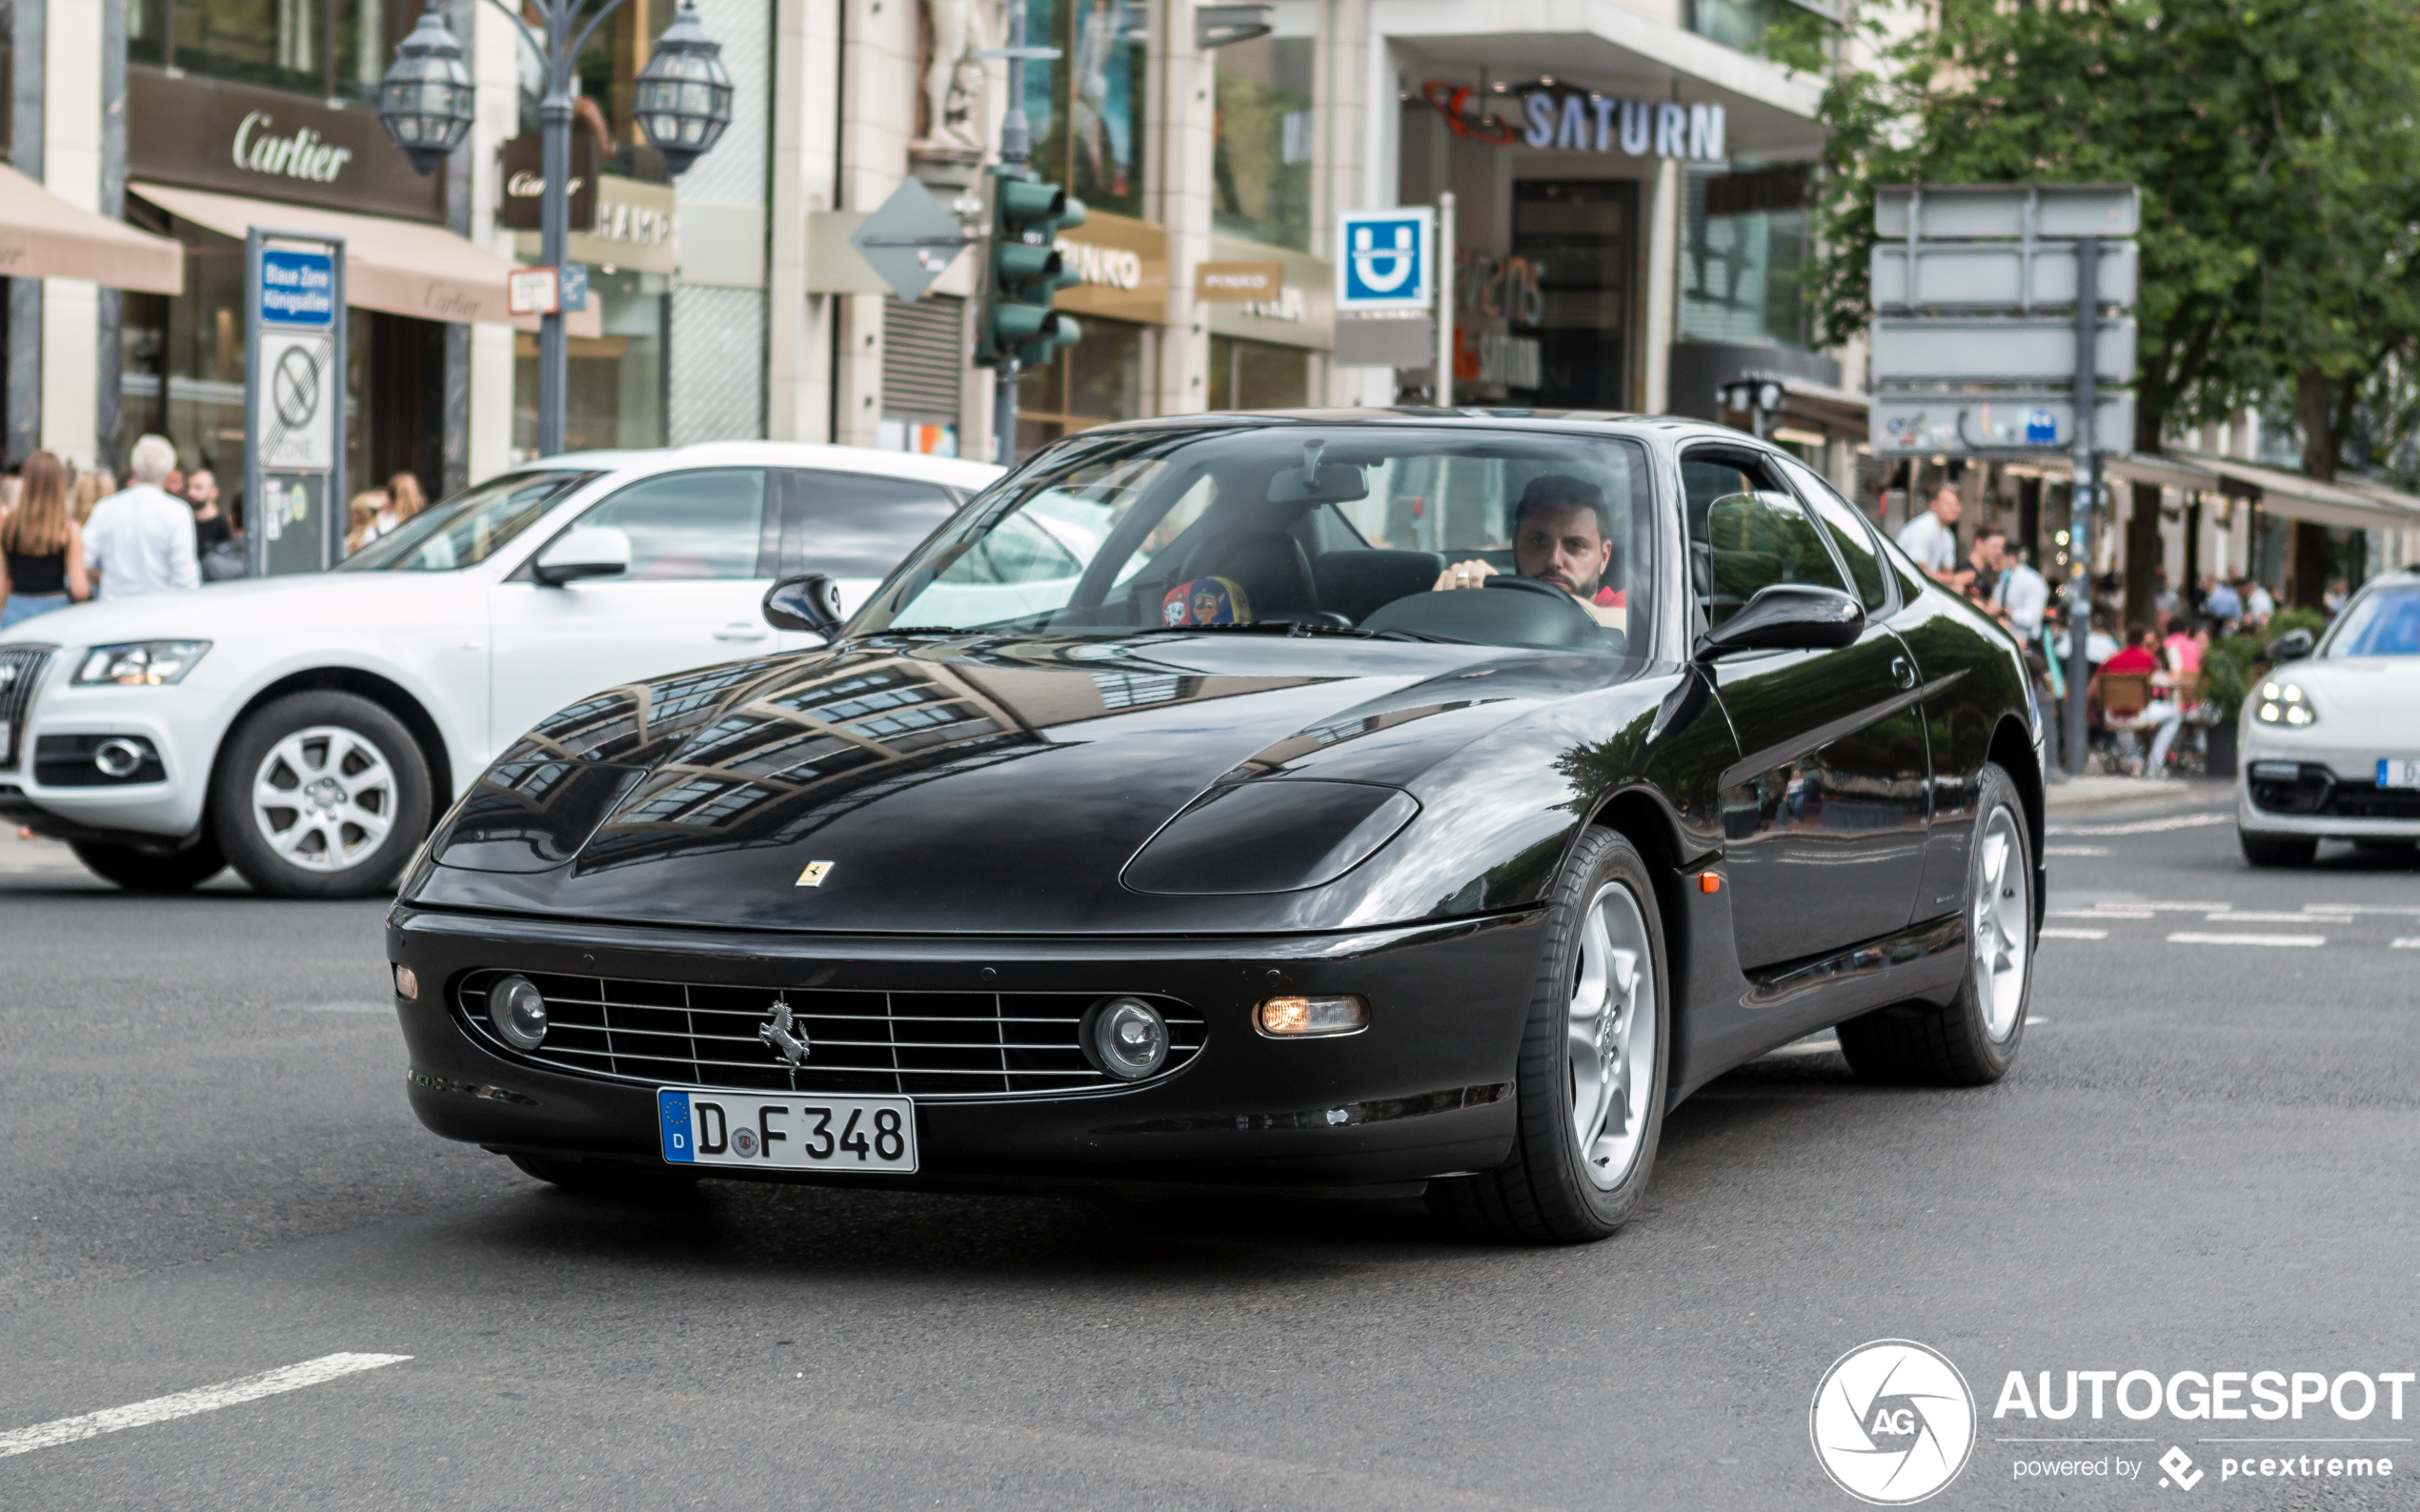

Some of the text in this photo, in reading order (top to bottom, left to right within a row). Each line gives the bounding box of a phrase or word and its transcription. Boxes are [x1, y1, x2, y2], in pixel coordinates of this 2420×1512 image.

[232, 110, 352, 183] Cartier
[1526, 92, 1725, 160] SATURN
[266, 263, 328, 288] Blaue Zone
[1355, 227, 1412, 292] U
[265, 290, 329, 314] Königsallee
[425, 279, 482, 316] Cartier
[695, 1102, 904, 1161] D F 348
